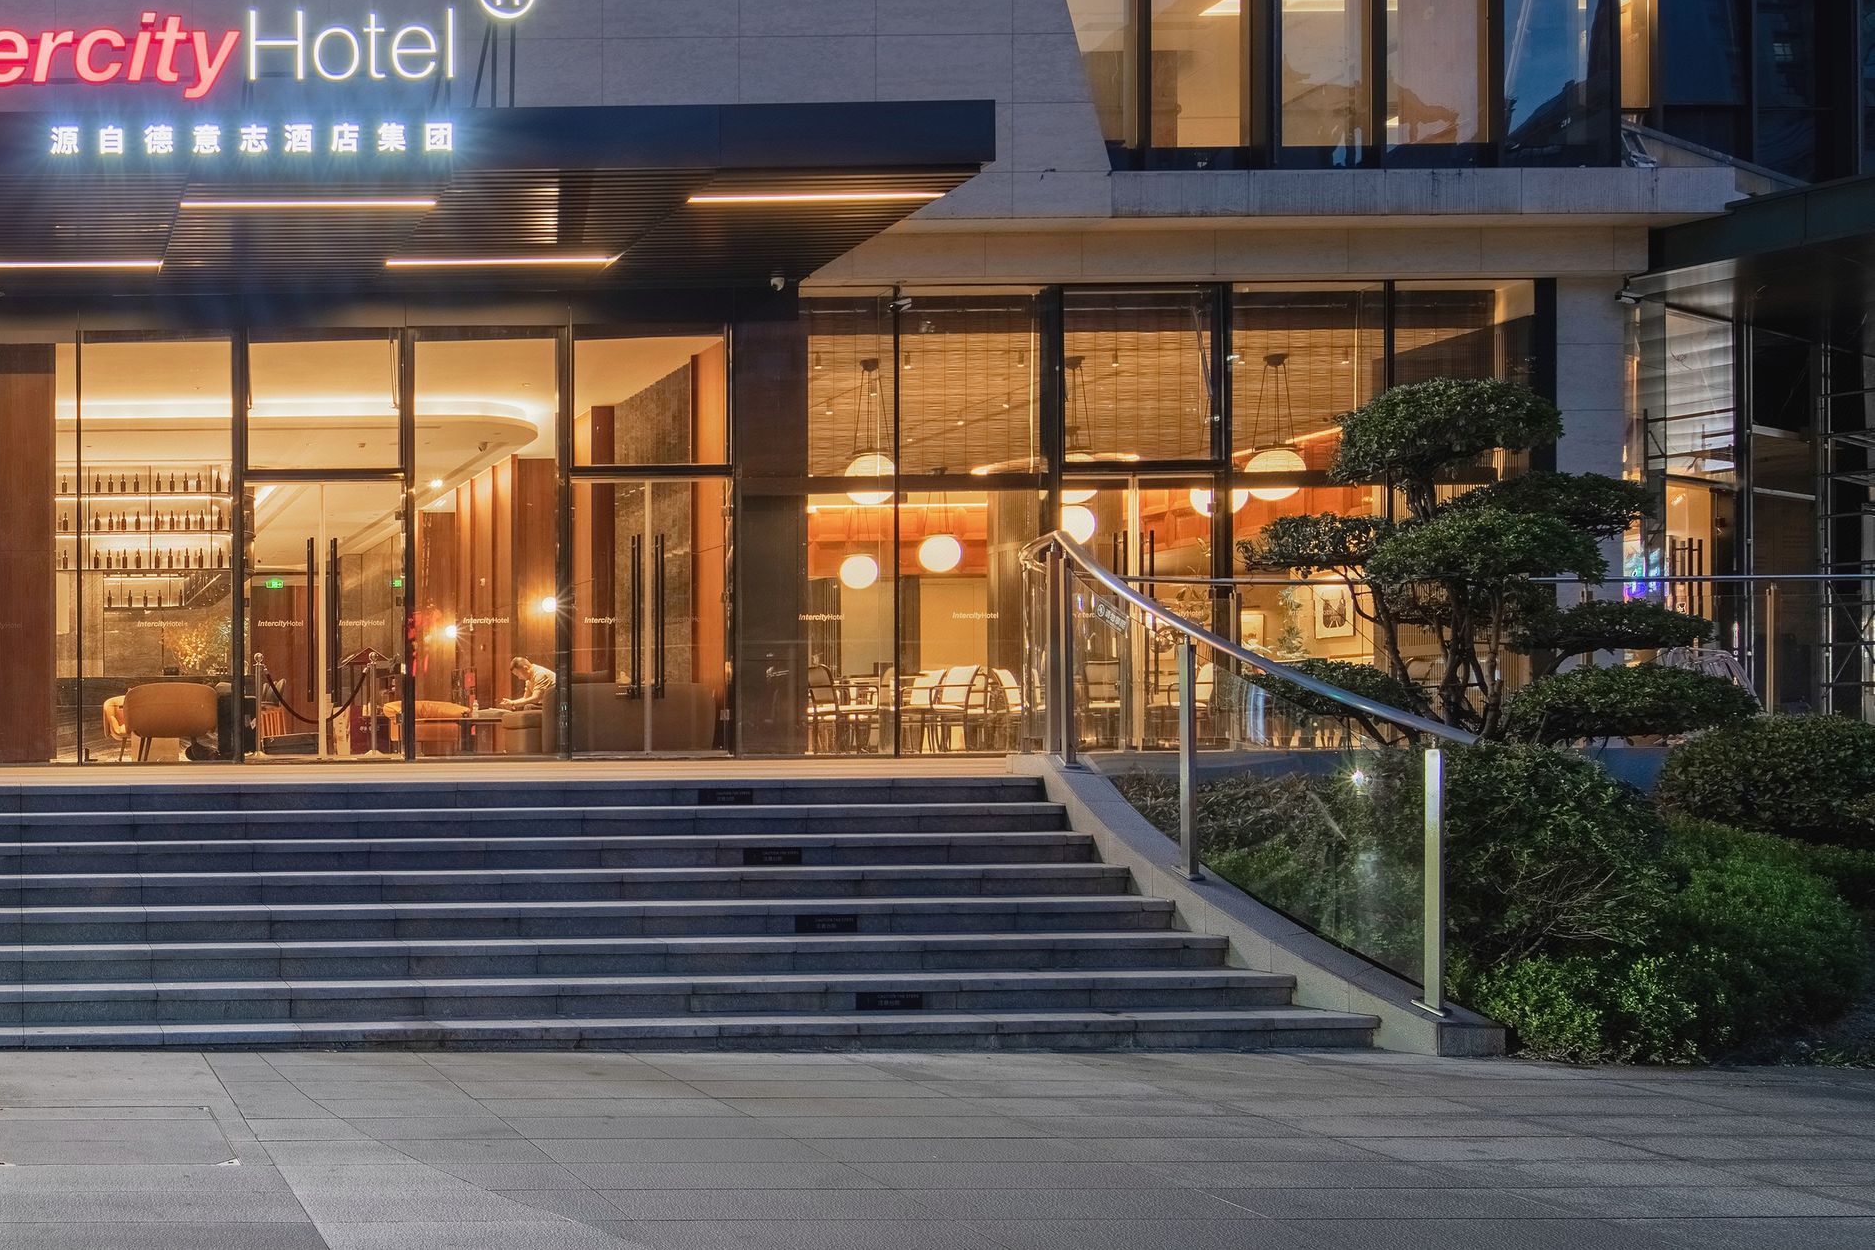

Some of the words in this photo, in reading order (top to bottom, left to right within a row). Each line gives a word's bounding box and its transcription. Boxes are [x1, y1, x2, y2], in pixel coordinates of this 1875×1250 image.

[50, 122, 454, 155] 源自德意志酒店集团
